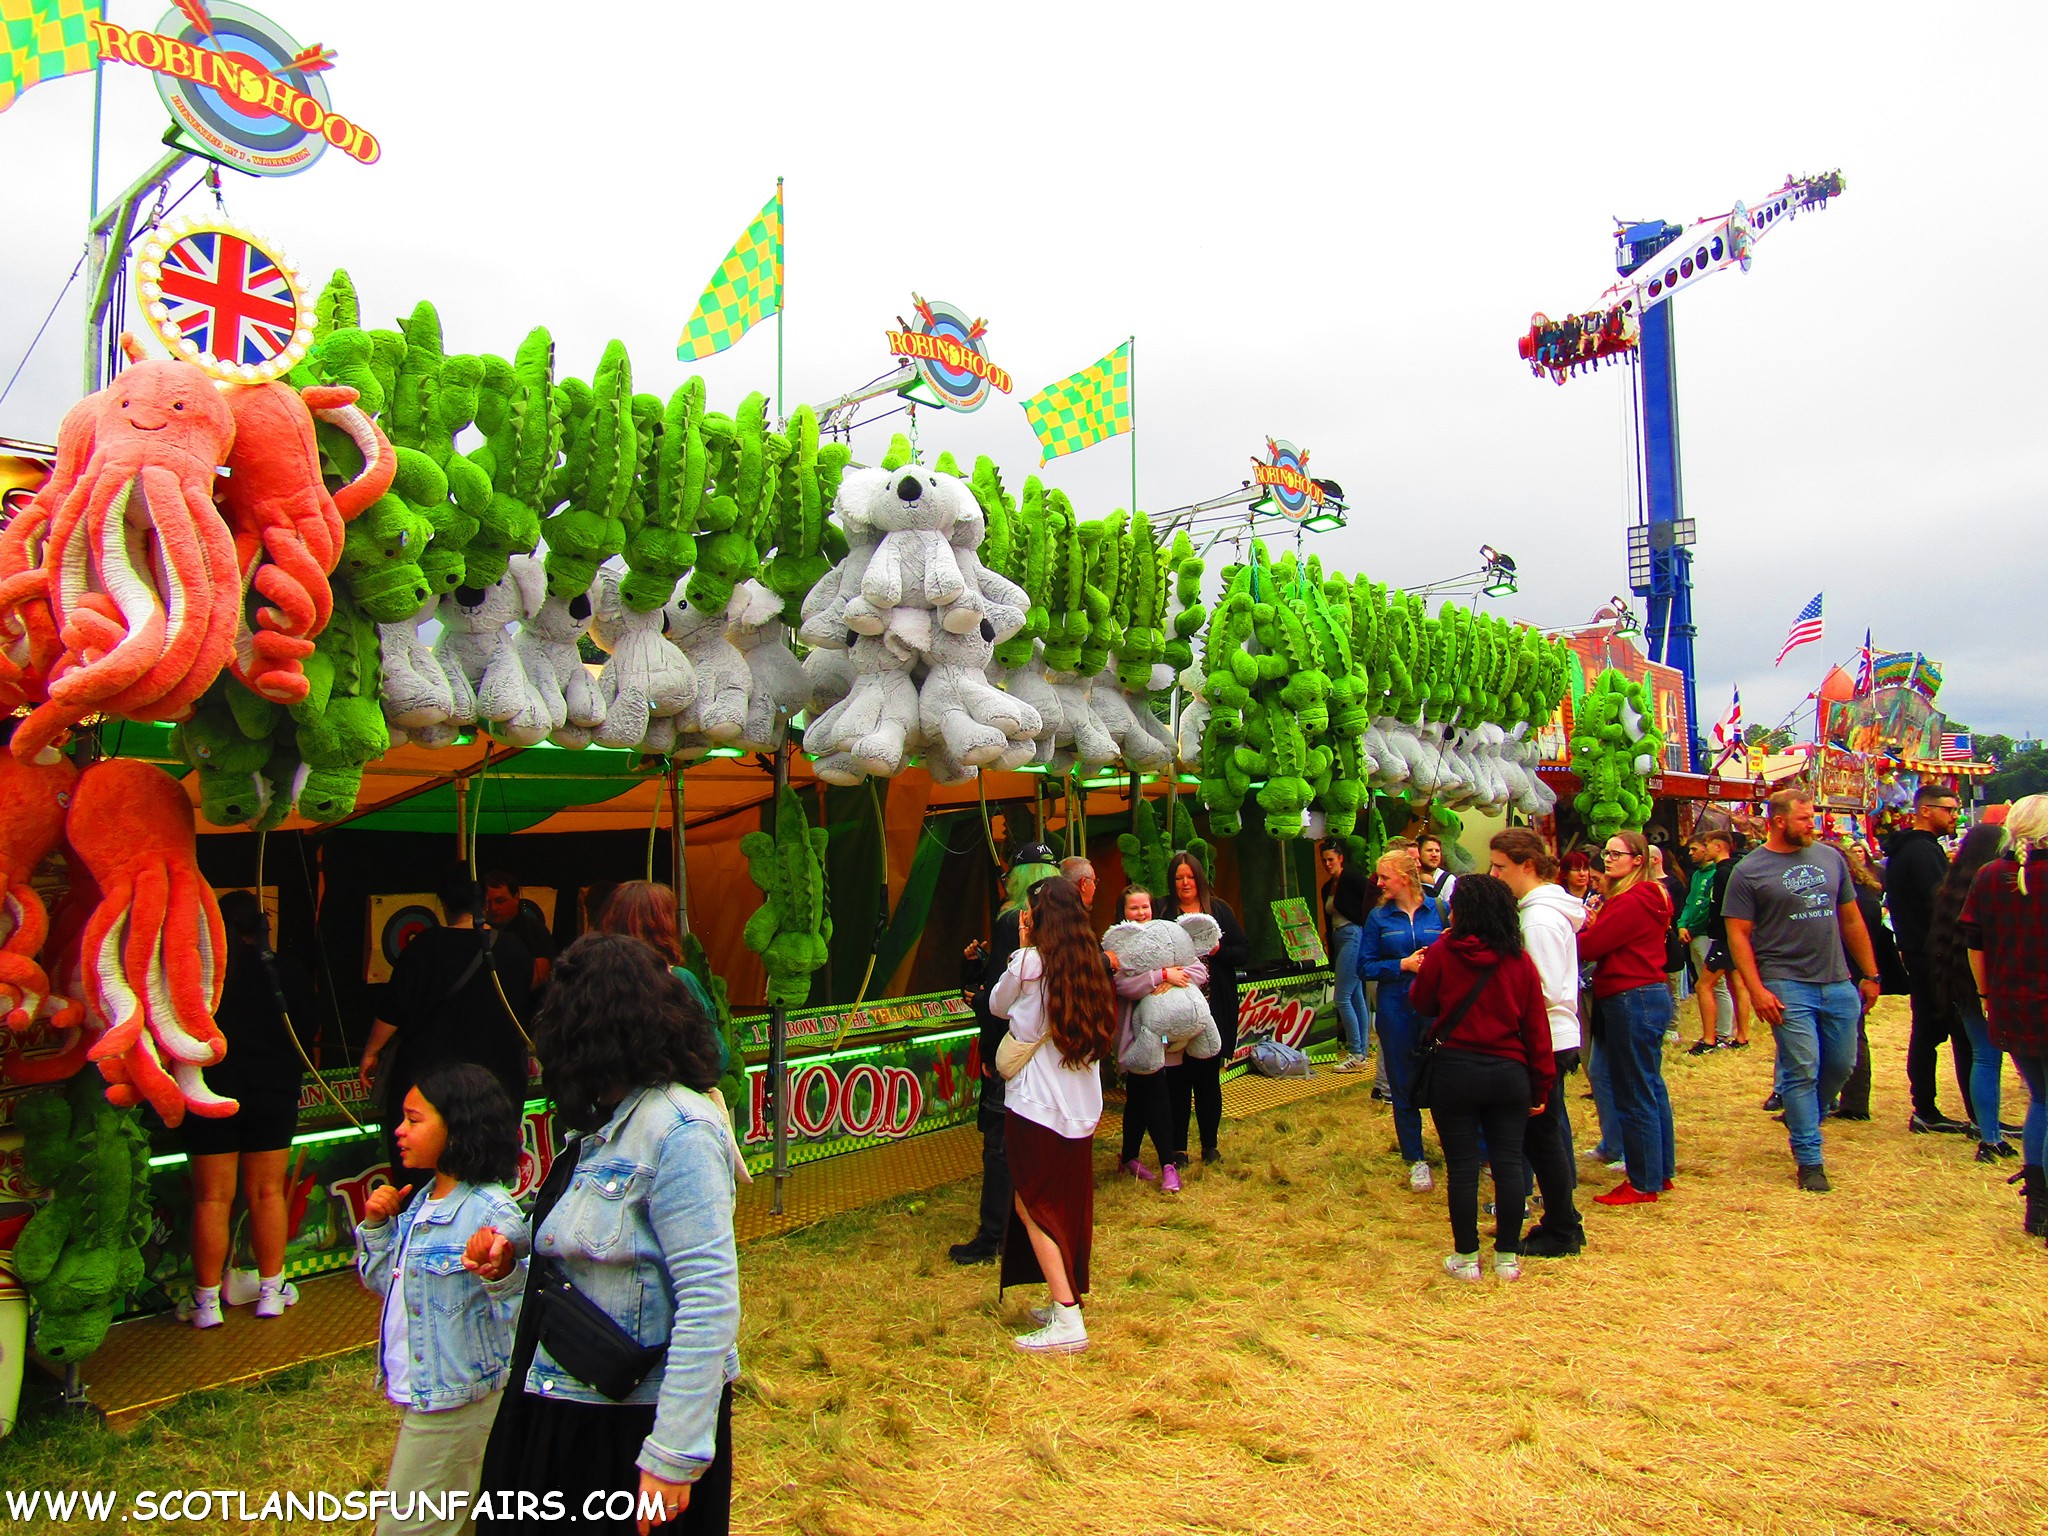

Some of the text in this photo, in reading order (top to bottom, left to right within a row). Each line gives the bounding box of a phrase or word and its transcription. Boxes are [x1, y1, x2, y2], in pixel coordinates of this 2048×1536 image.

[91, 21, 381, 164] ROBIN HOOD
[886, 330, 950, 363] ROBIN
[959, 344, 1013, 394] HOOD
[1252, 465, 1289, 486] ROBIN
[1293, 470, 1325, 507] HOOD
[821, 1014, 840, 1034] IN
[840, 1011, 870, 1030] THE
[870, 1003, 923, 1026] YELLOW
[923, 1001, 943, 1018] TO
